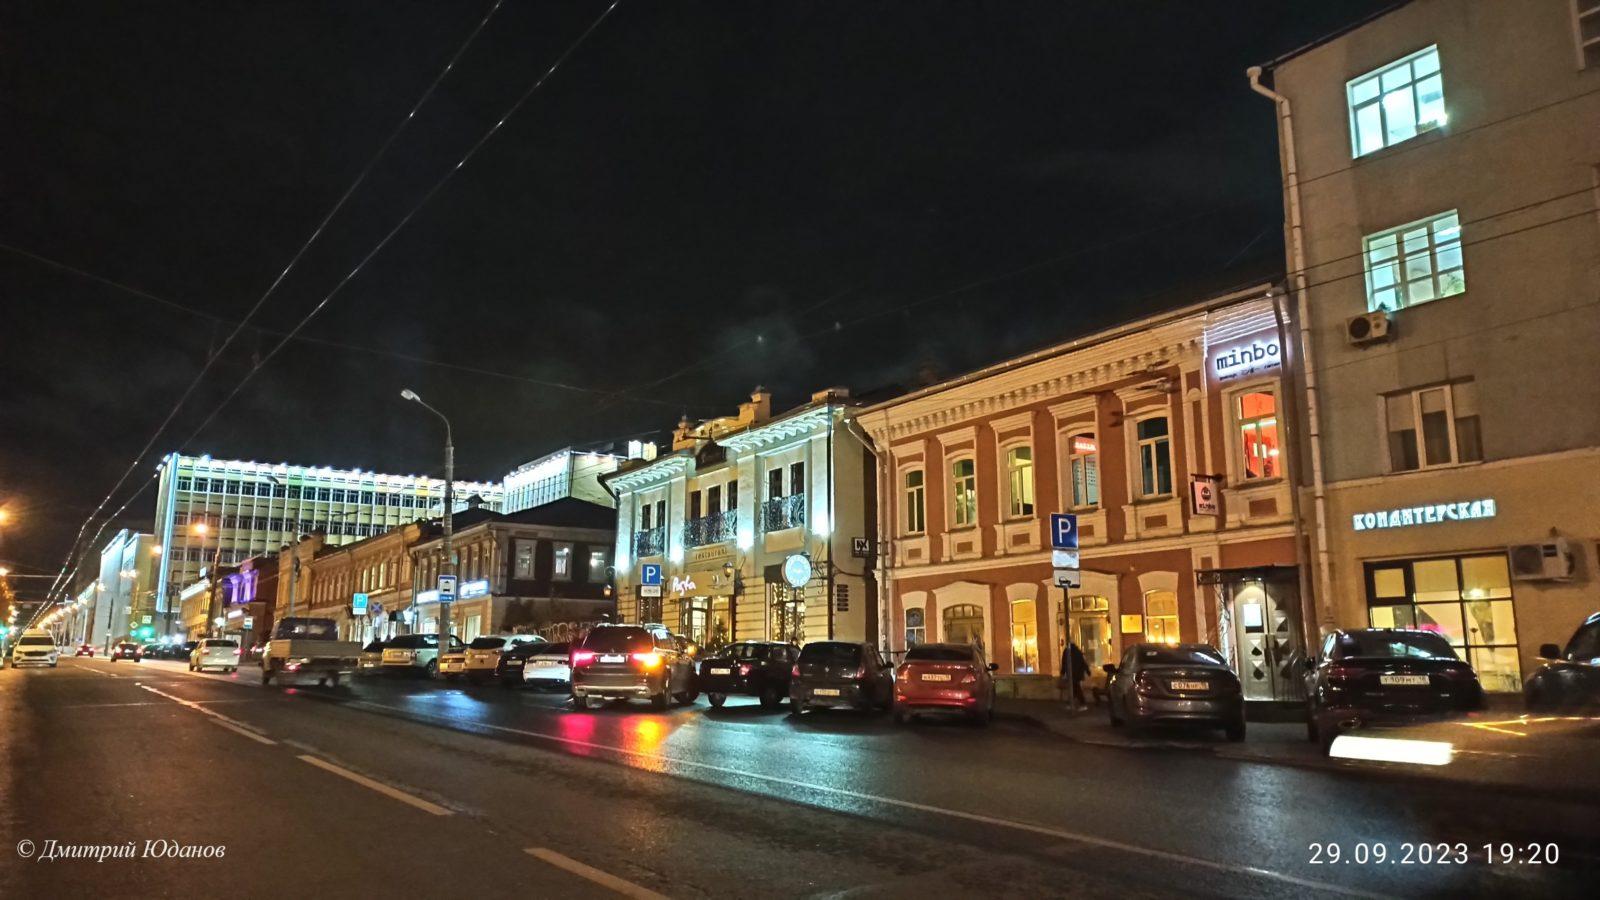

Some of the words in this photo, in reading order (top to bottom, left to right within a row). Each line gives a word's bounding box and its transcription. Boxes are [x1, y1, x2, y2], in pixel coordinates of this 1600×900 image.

[1216, 343, 1279, 371] minbo
[1352, 498, 1496, 531] КОНДИТЕРСКАЯ
[695, 547, 728, 561] restaurant
